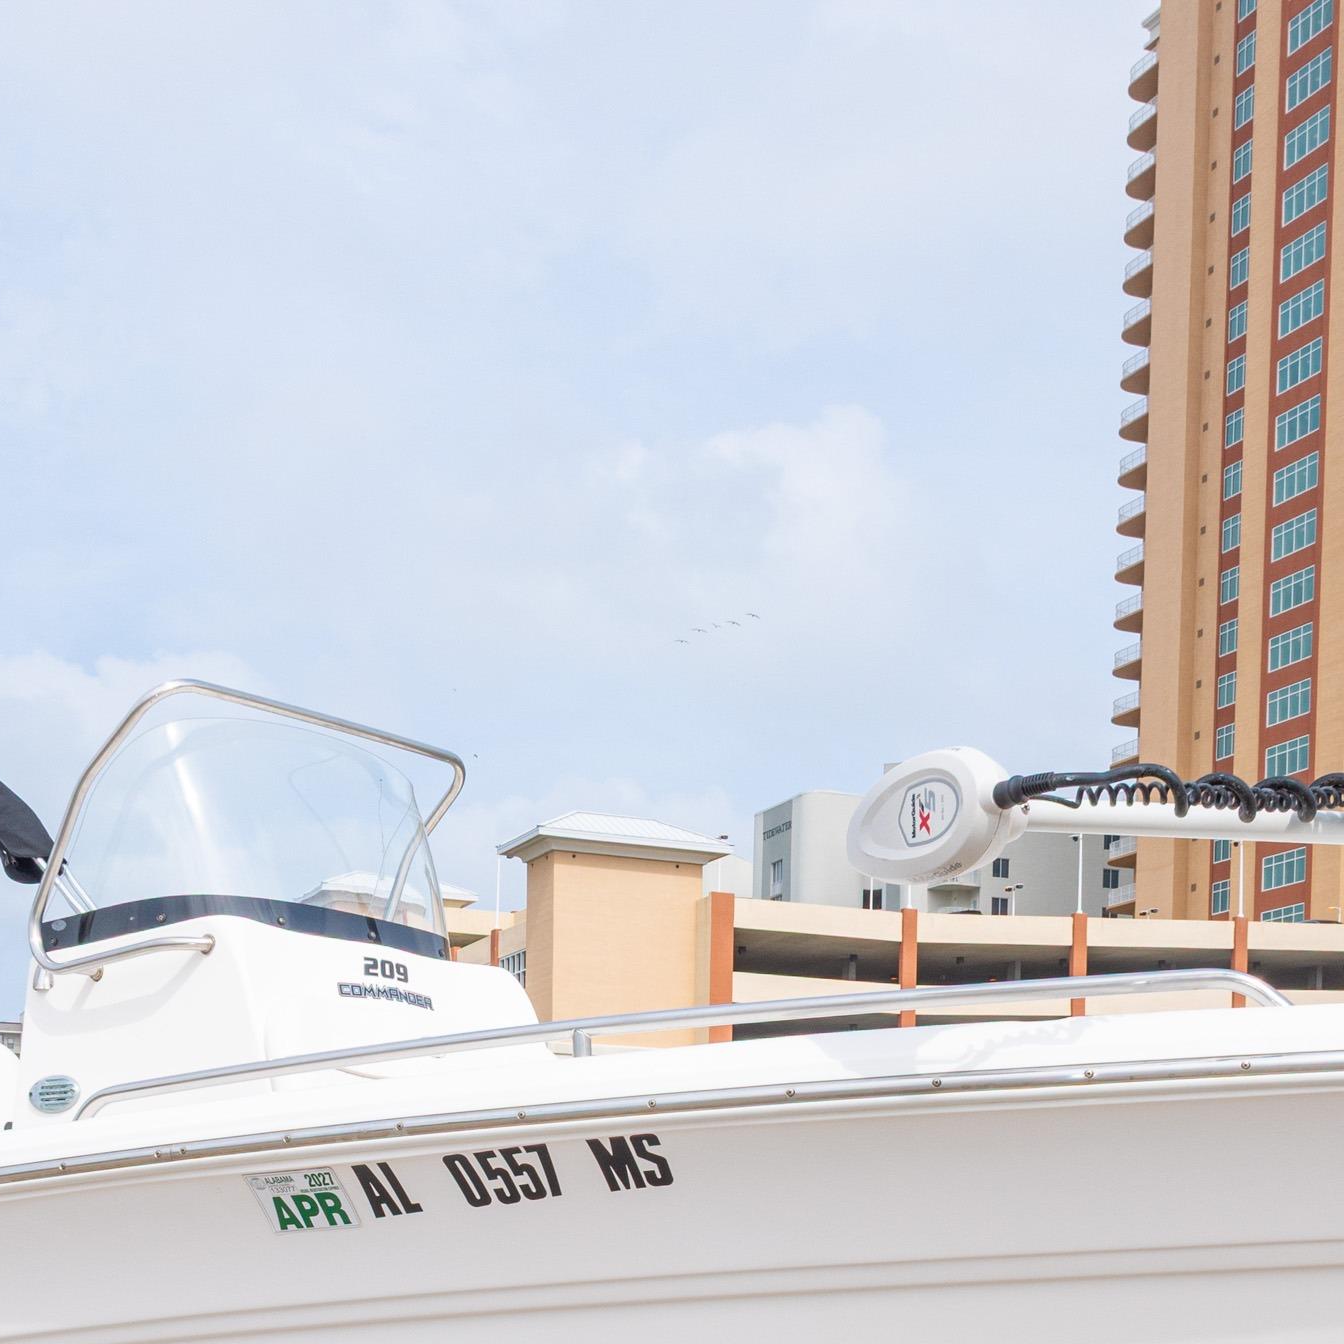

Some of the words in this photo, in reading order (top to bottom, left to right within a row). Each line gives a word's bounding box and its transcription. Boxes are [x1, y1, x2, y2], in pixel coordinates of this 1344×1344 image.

[363, 957, 409, 983] 209
[337, 982, 434, 1011] COMMANDER
[264, 1175, 295, 1185] ALABAMA
[304, 1172, 335, 1188] 2027
[351, 1162, 424, 1218] AL
[442, 1143, 563, 1208] 0557
[585, 1133, 674, 1192] MS
[272, 1191, 353, 1231] APR
